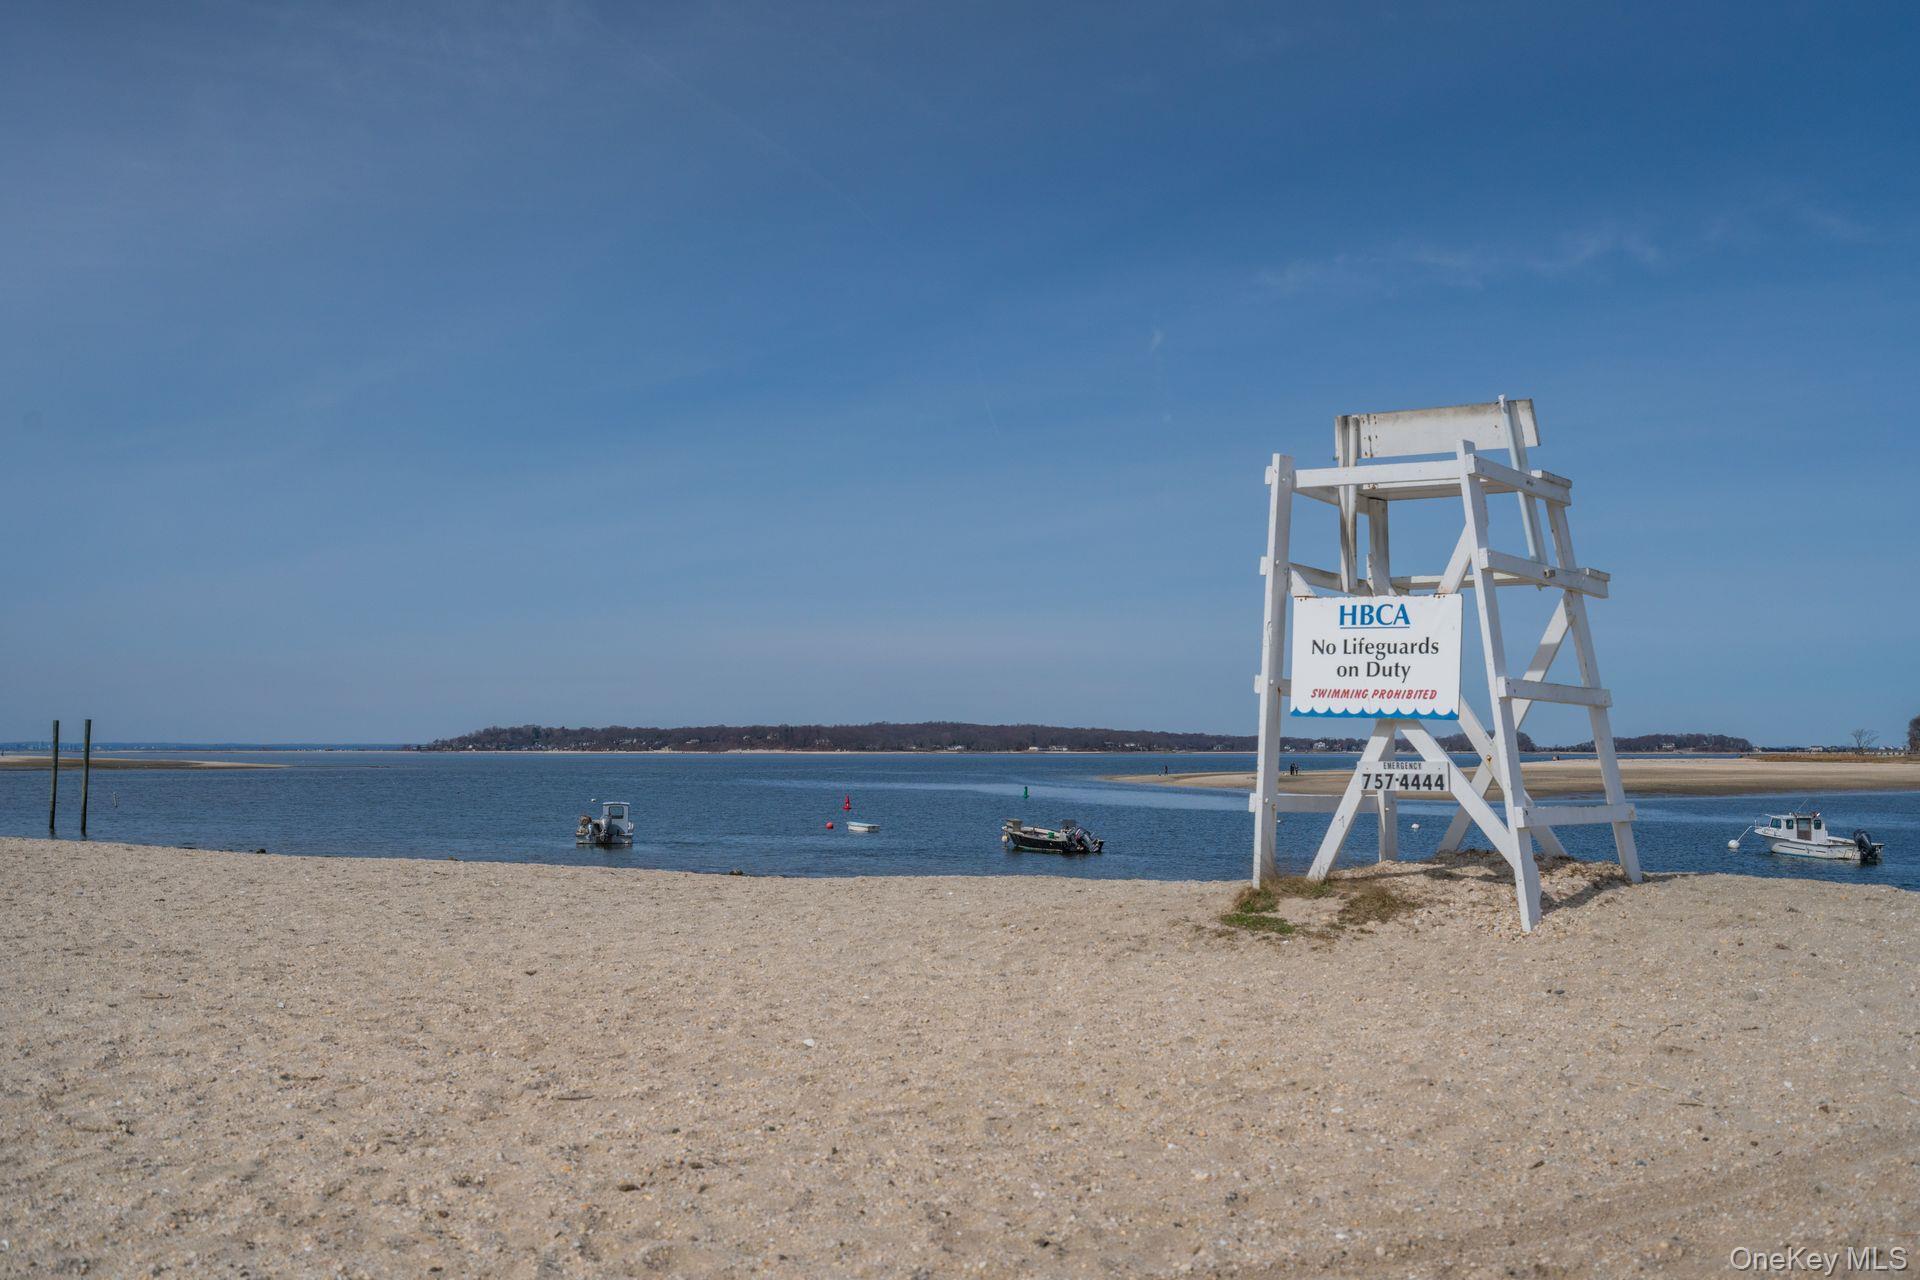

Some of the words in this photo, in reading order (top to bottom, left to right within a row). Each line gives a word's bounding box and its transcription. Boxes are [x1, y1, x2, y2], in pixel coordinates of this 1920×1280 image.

[1339, 603, 1411, 626] HBCA
[1311, 639, 1337, 655] No
[1343, 637, 1439, 660] Lifeguards
[1336, 665, 1359, 677] on
[1366, 661, 1411, 683] Duty
[1310, 688, 1369, 700] SWIMMING
[1371, 688, 1438, 700] PROHIBITED
[1383, 762, 1422, 770] EMERGENCY
